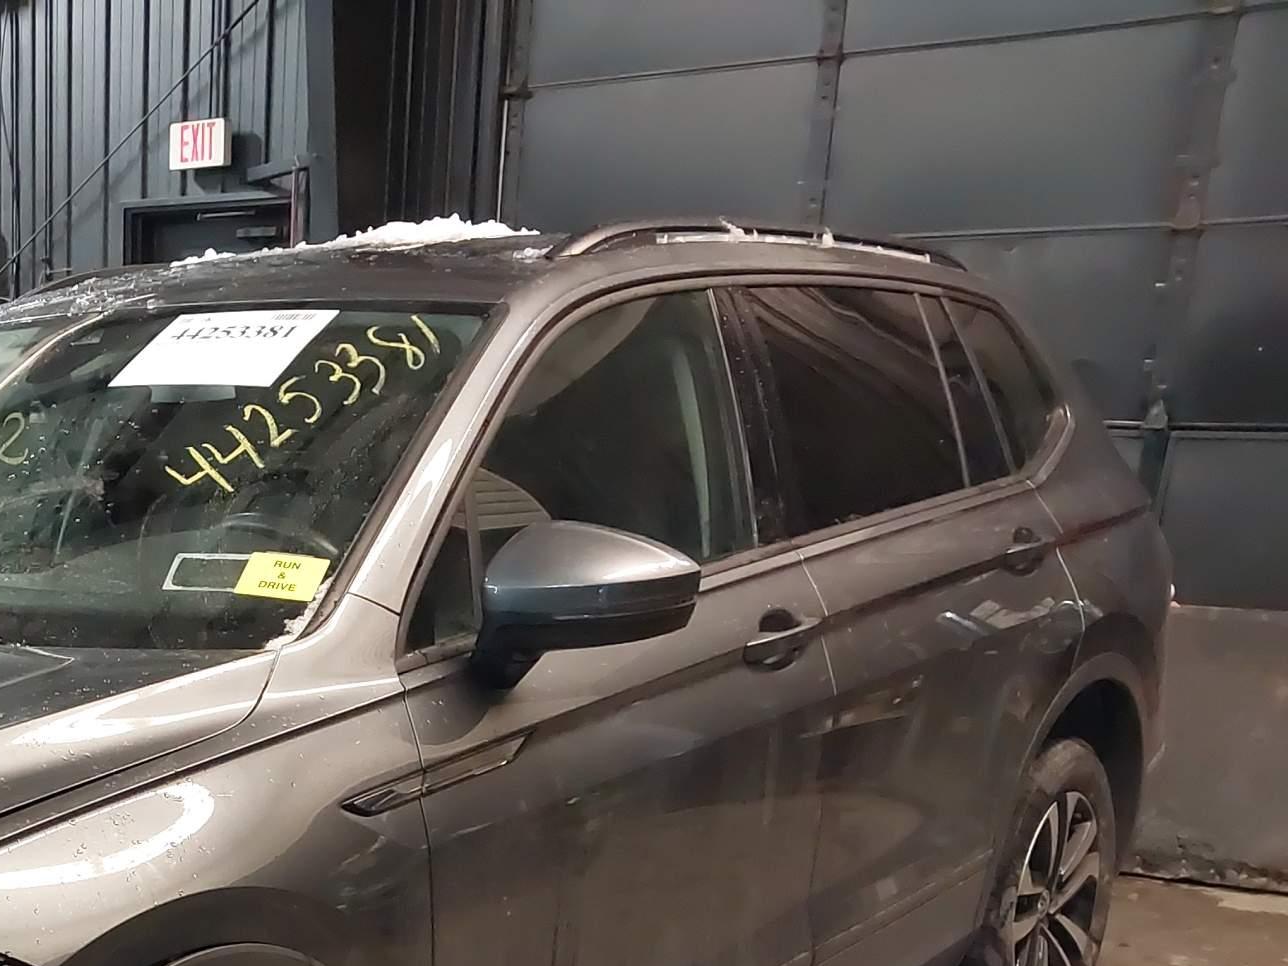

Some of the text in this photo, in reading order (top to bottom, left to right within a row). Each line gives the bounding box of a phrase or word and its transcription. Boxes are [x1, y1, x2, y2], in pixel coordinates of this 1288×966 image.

[180, 121, 217, 164] EXIT
[171, 324, 298, 341] 44253381
[165, 314, 440, 493] 44253381
[273, 559, 302, 570] RUN
[277, 571, 287, 580] &
[257, 580, 297, 592] DRIVE
